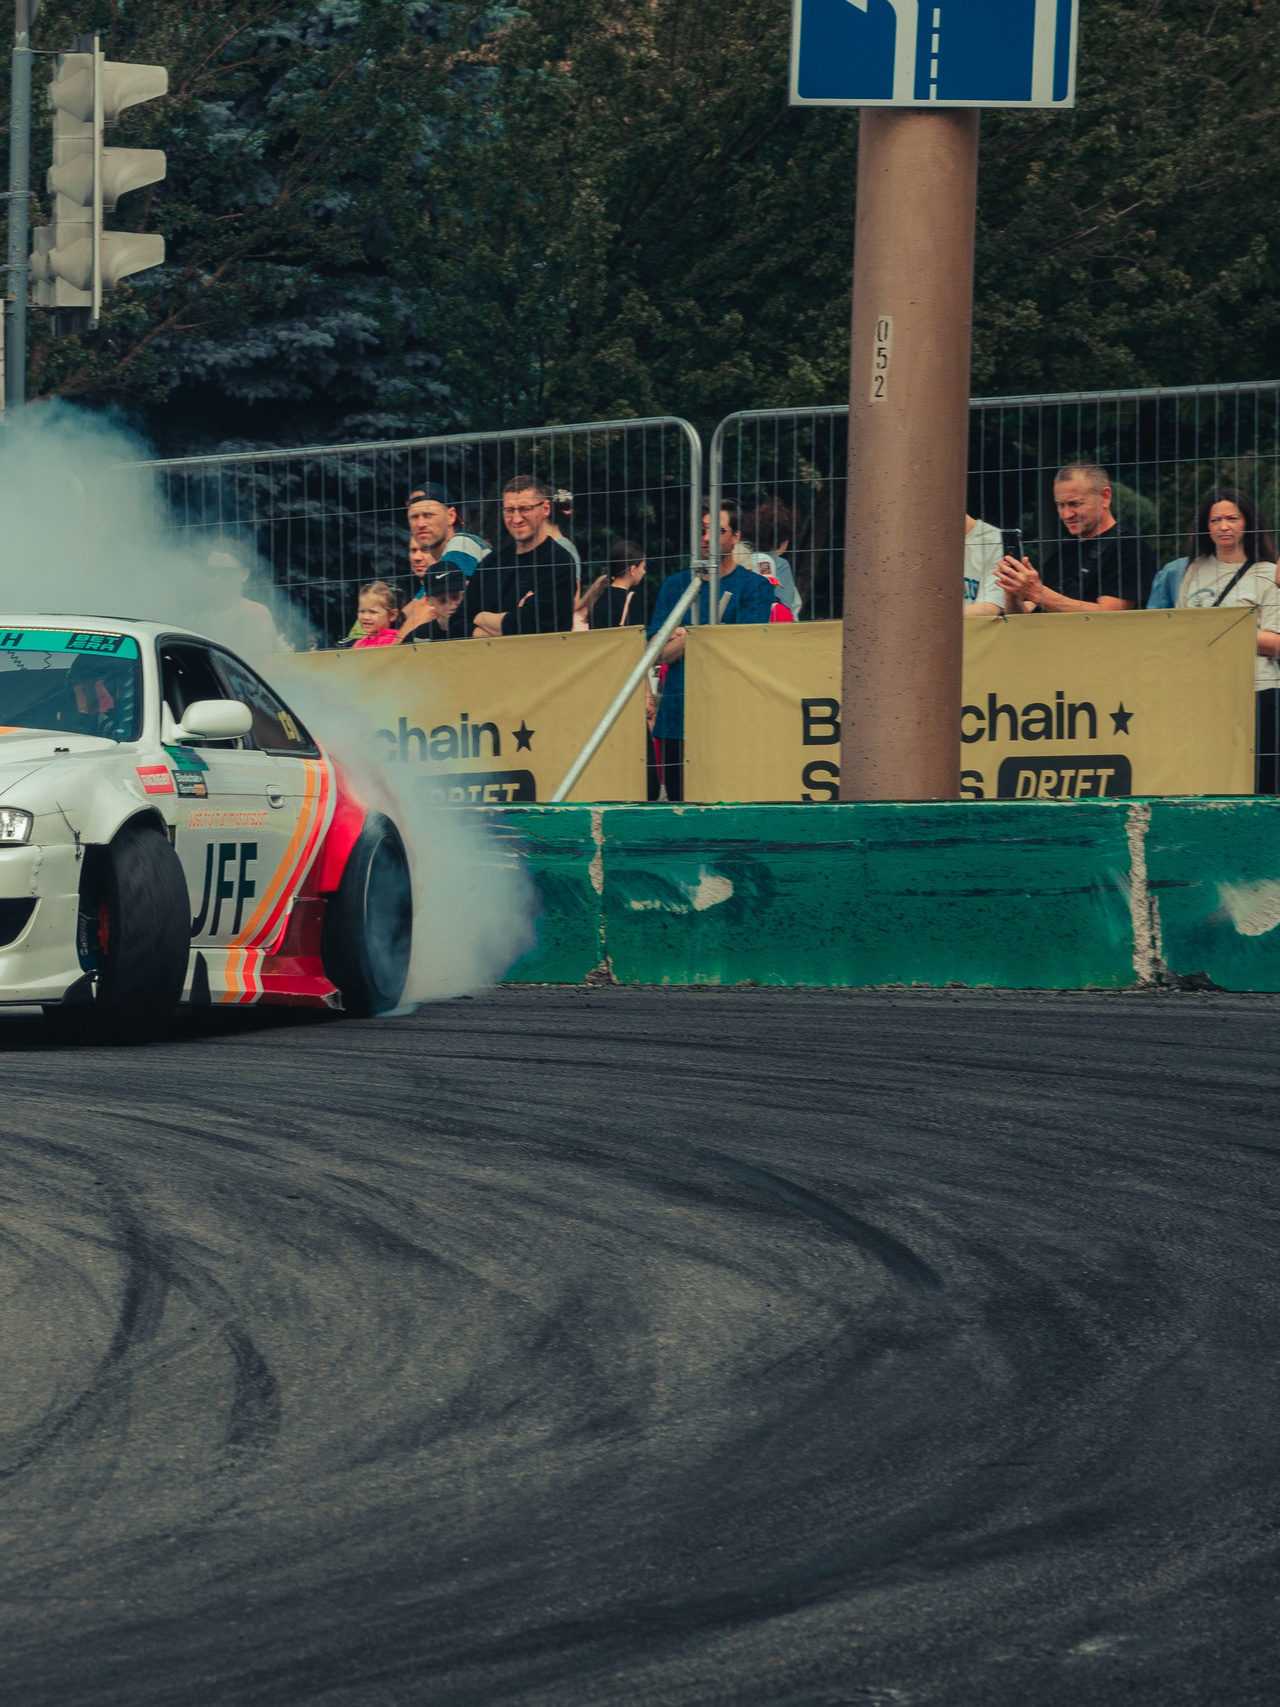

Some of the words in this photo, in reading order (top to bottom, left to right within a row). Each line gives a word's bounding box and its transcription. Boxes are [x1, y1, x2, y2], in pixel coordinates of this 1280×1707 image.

[874, 319, 889, 398] 052
[75, 633, 121, 645] BET
[1015, 768, 1116, 799] DRIFT
[191, 842, 258, 938] JFF
